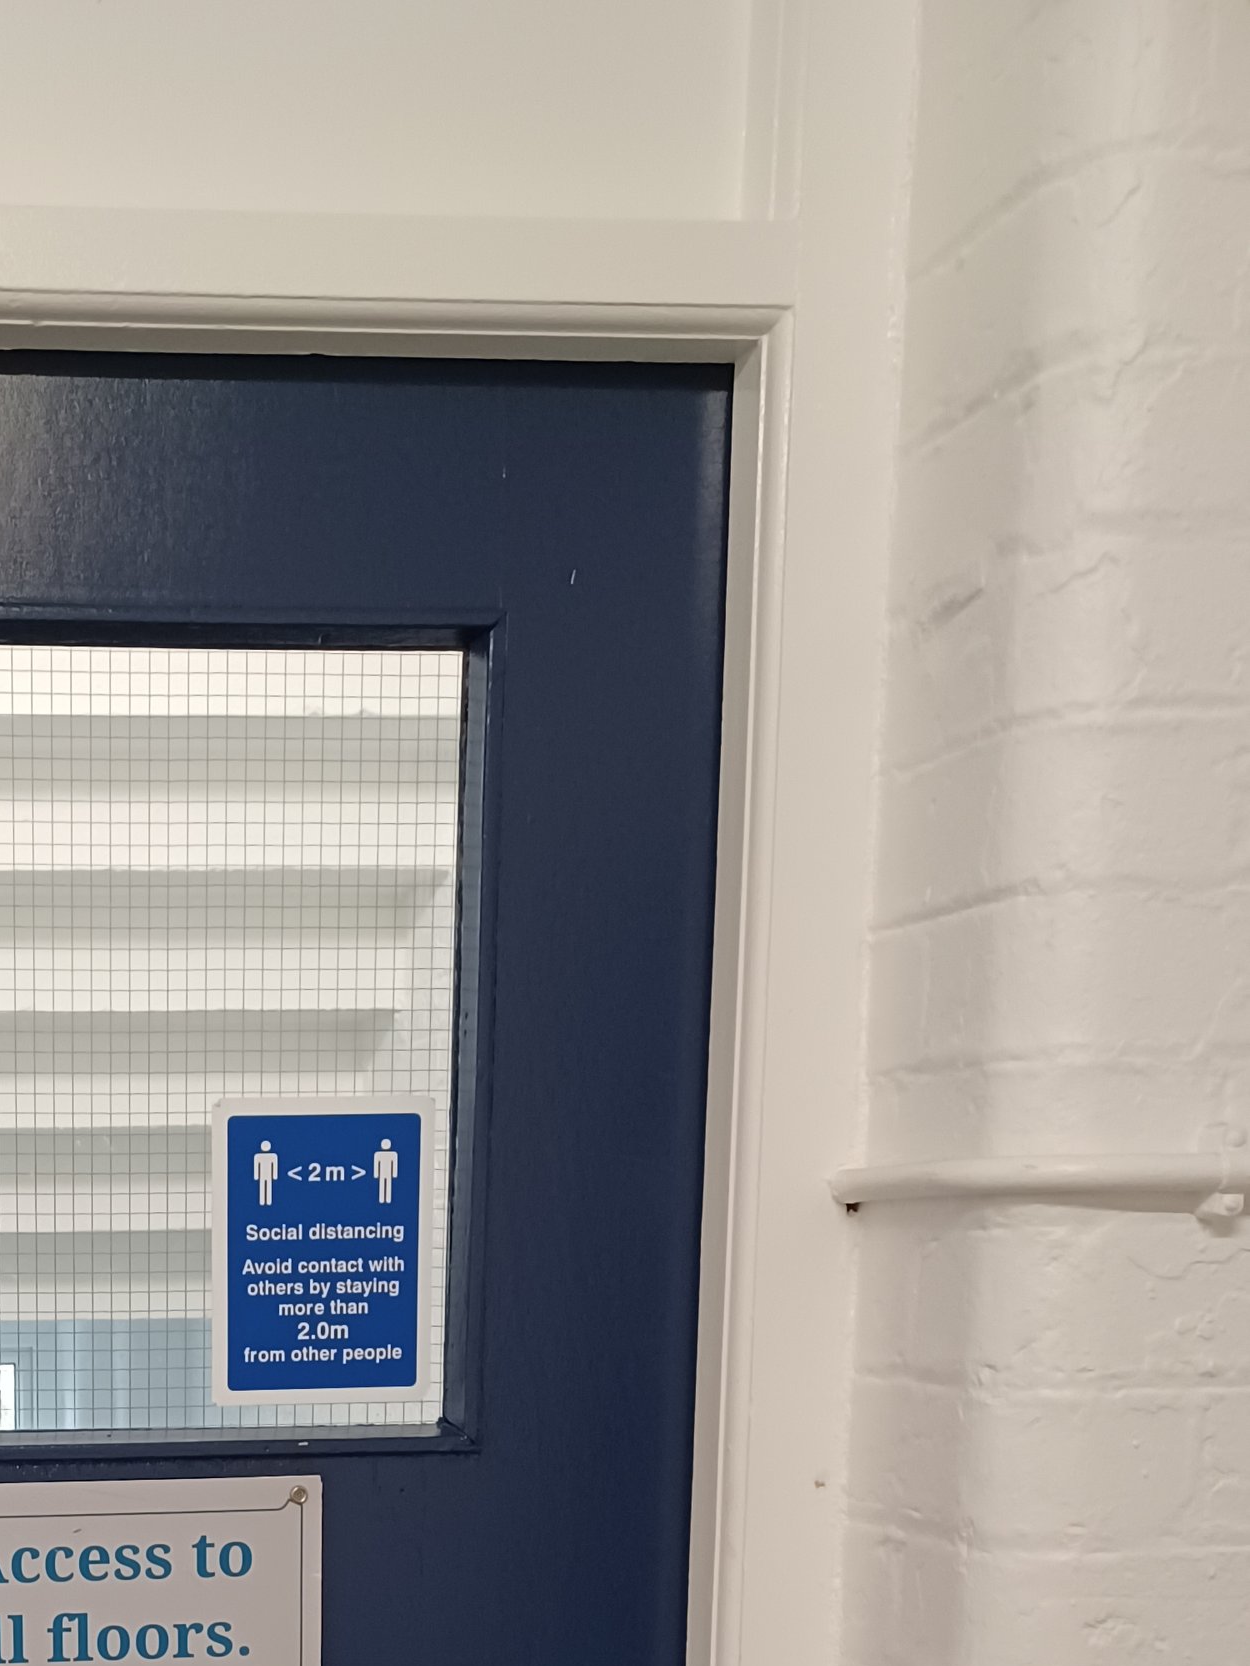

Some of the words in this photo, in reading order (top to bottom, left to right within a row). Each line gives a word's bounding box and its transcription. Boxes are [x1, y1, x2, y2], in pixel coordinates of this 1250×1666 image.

[246, 1224, 303, 1241] Social
[308, 1223, 405, 1242] distancing
[242, 1258, 292, 1275] Avoid
[297, 1257, 364, 1273] contact
[368, 1256, 405, 1272] with
[247, 1279, 304, 1296] others
[309, 1278, 331, 1298] by
[336, 1277, 400, 1296] staying
[278, 1302, 325, 1316] more
[330, 1299, 369, 1315] than
[297, 1322, 349, 1340] 2.0m
[244, 1347, 286, 1363] from
[291, 1346, 337, 1362] other
[342, 1344, 402, 1364] people
[192, 1534, 253, 1579] to
[46, 1612, 251, 1663] floors.
